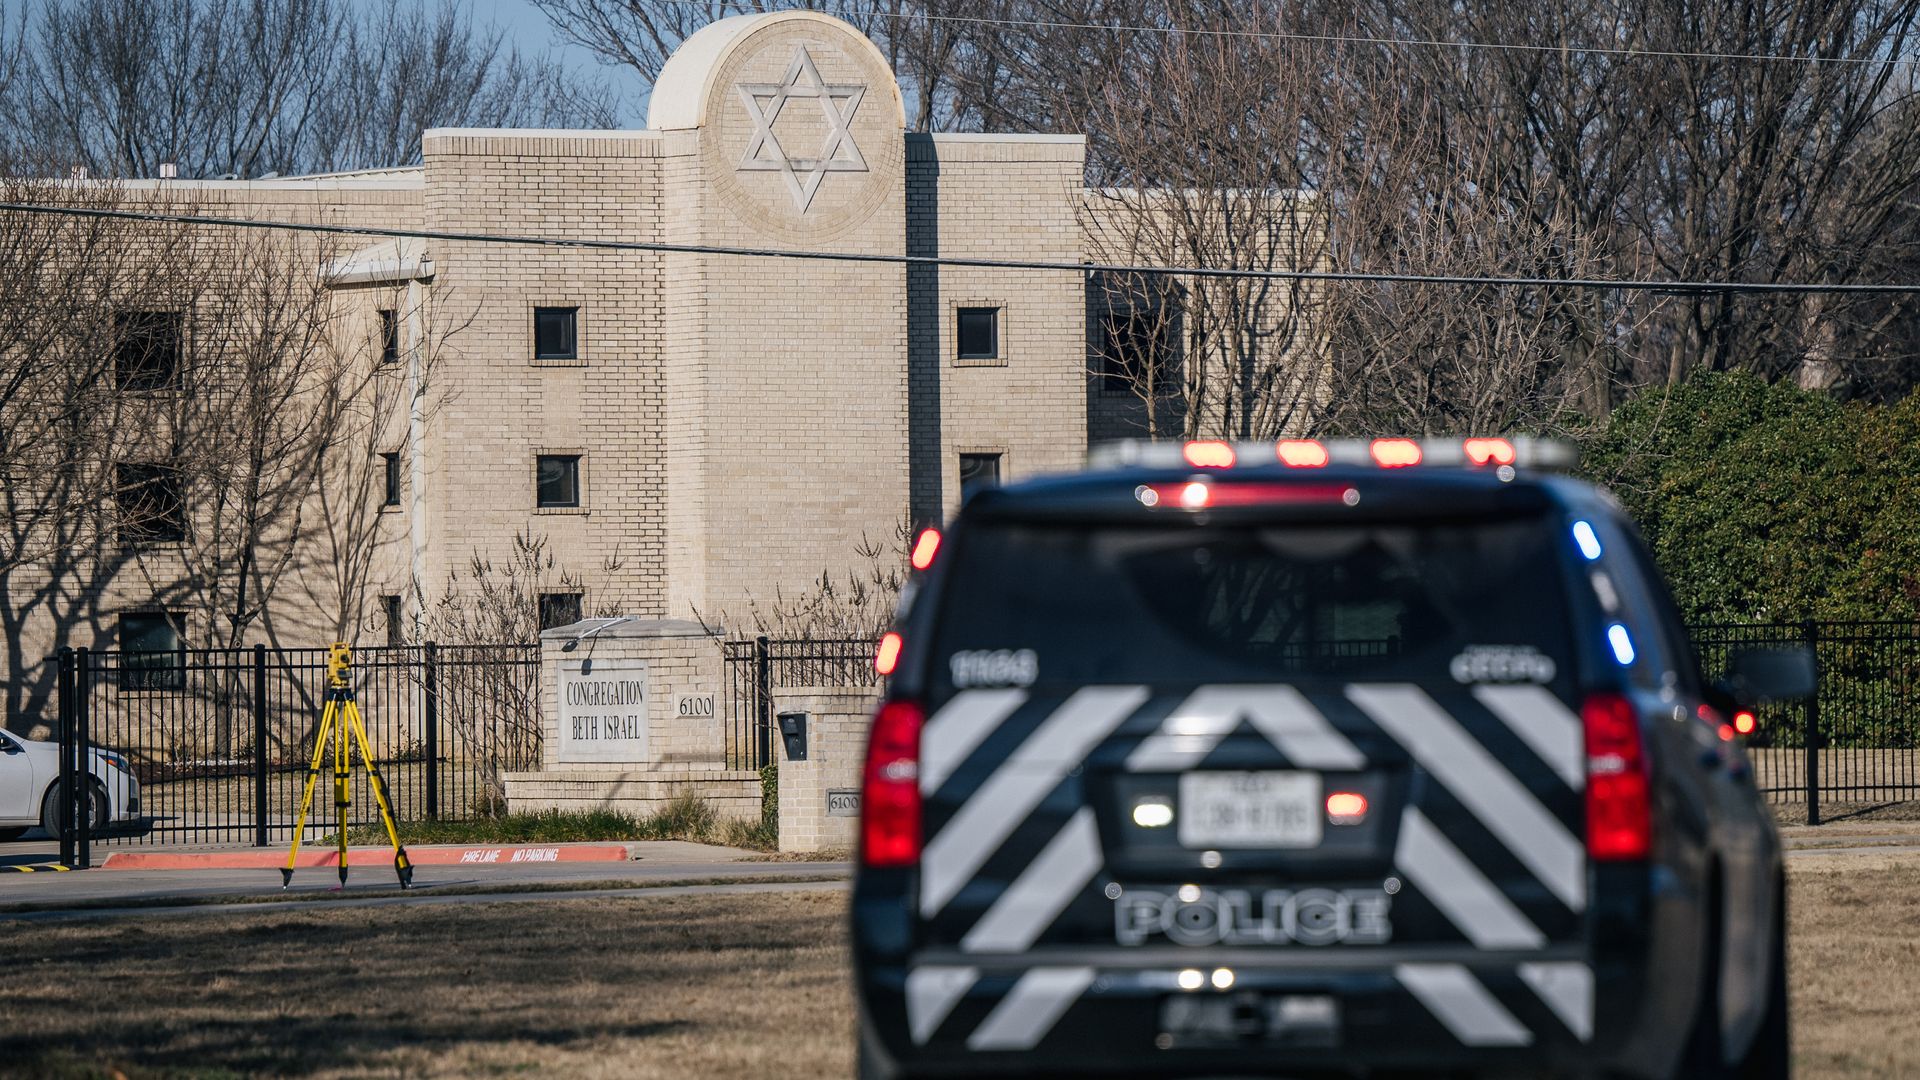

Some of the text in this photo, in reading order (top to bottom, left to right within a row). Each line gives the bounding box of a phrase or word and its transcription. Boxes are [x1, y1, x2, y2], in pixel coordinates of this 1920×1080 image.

[567, 681, 643, 705] CONGREGATION
[680, 697, 711, 715] 6100
[572, 715, 640, 740] BETH ISRAEL
[831, 797, 858, 809] 6100
[460, 848, 559, 863] FIRE LANE NO PARKING
[1115, 888, 1391, 946] POLICE
